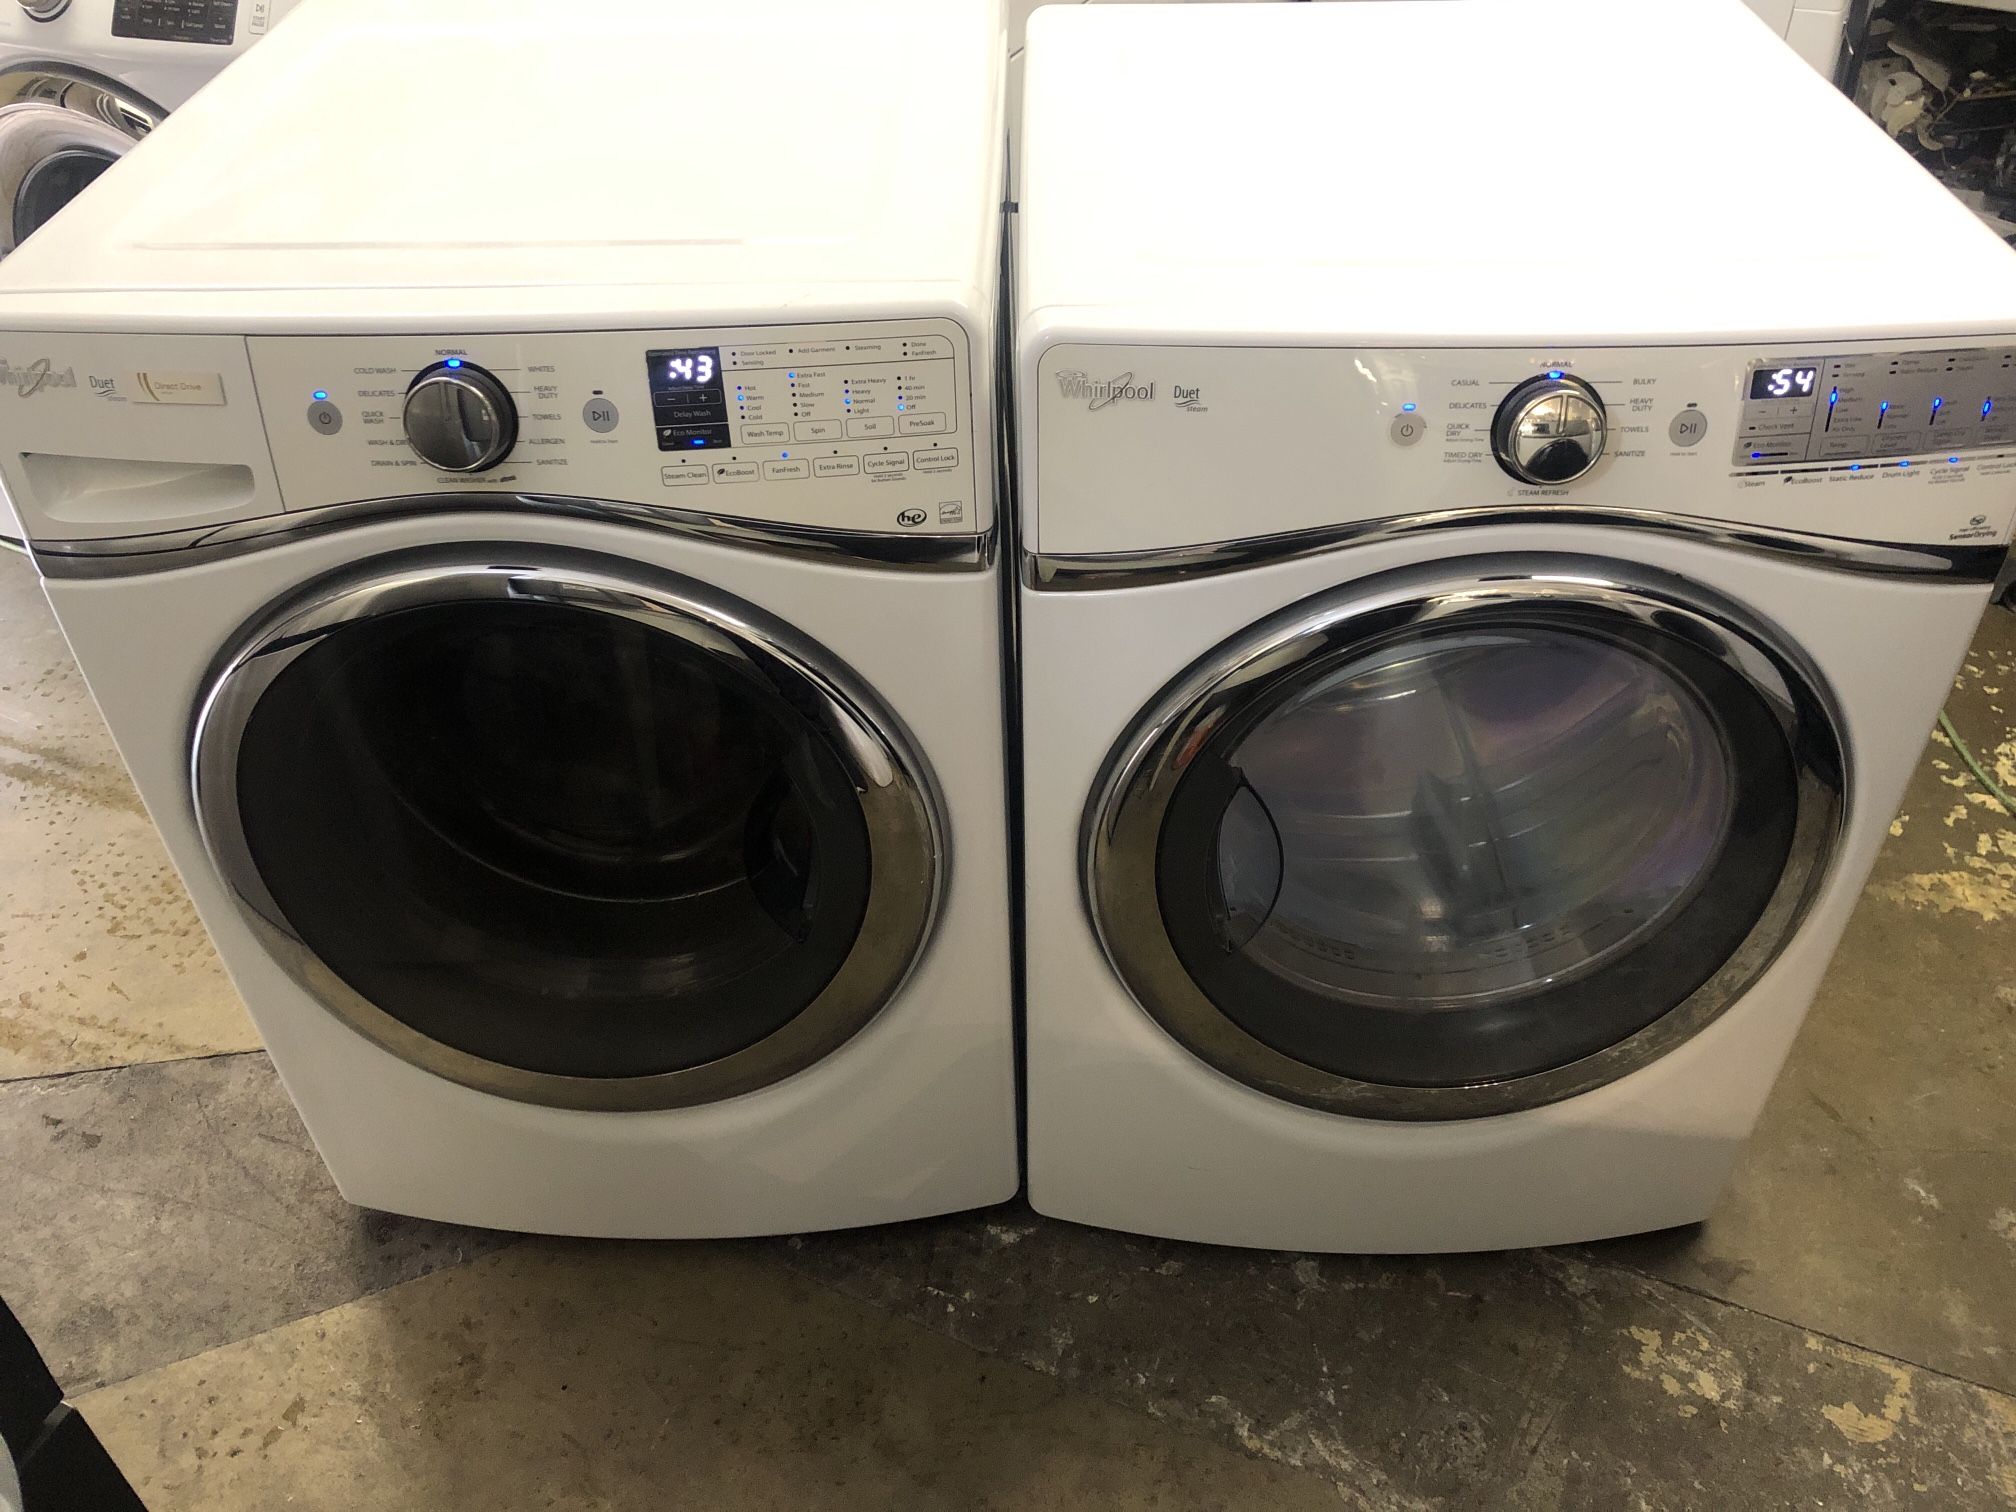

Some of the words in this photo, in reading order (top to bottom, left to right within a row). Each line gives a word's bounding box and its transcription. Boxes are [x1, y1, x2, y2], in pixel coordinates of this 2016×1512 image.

[88, 375, 115, 388] Duet
[1058, 377, 1154, 403] Whirlpool
[1173, 385, 1200, 399] Duet
[916, 455, 939, 463] Control
